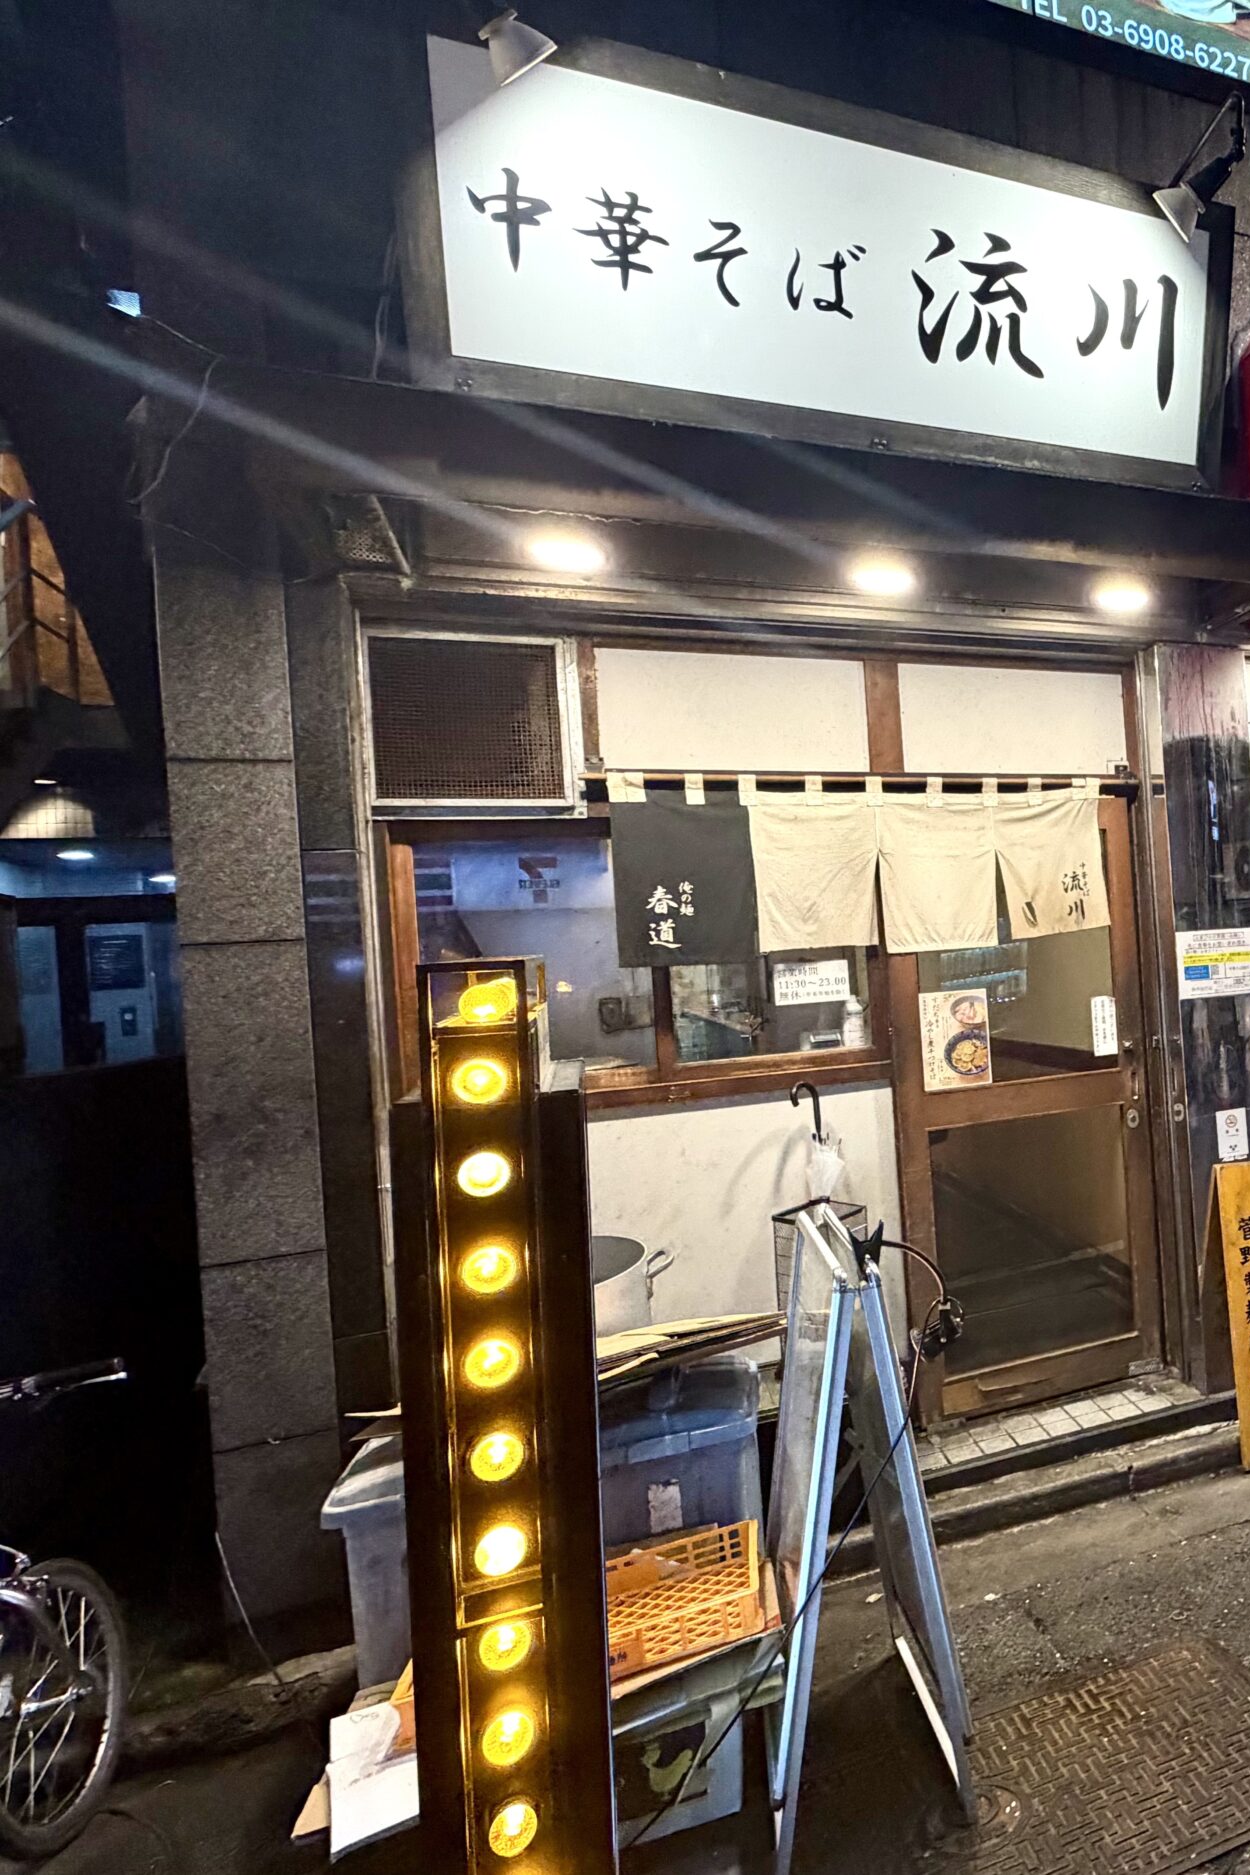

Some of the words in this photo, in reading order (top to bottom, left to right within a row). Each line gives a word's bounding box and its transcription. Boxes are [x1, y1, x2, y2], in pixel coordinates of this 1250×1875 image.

[1081, 5, 1250, 81] 03-6908-6227
[645, 885, 682, 949] 春道
[1061, 871, 1086, 921] 流川
